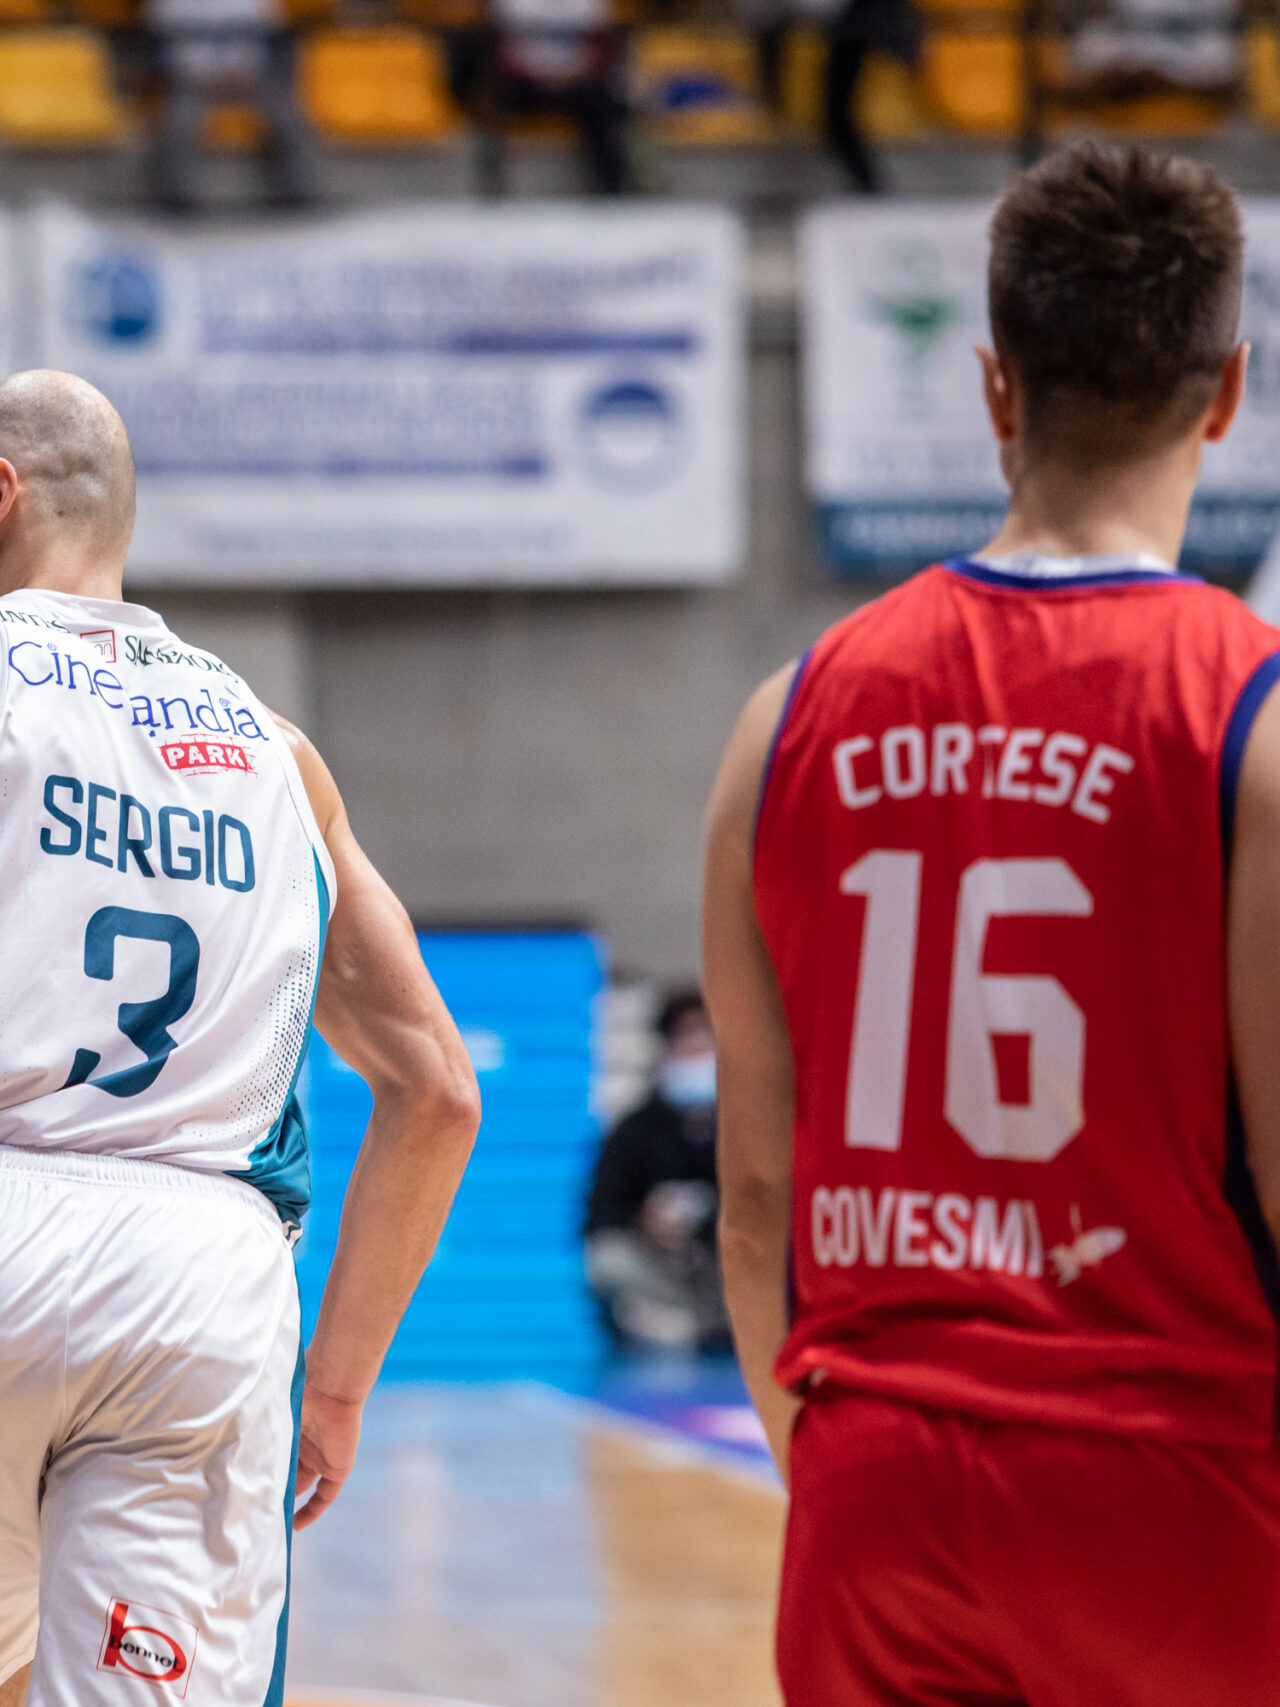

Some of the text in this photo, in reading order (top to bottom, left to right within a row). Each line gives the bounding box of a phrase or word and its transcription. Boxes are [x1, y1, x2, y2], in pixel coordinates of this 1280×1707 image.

[8, 640, 270, 741] Cineandia
[165, 745, 247, 768] PARK
[832, 722, 1135, 825] CORTESE
[39, 774, 256, 893] SERGIO
[53, 905, 201, 1098] 3
[839, 848, 1095, 1164] 16
[812, 1185, 1045, 1279] COVESMI
[109, 1634, 184, 1674] bennet
